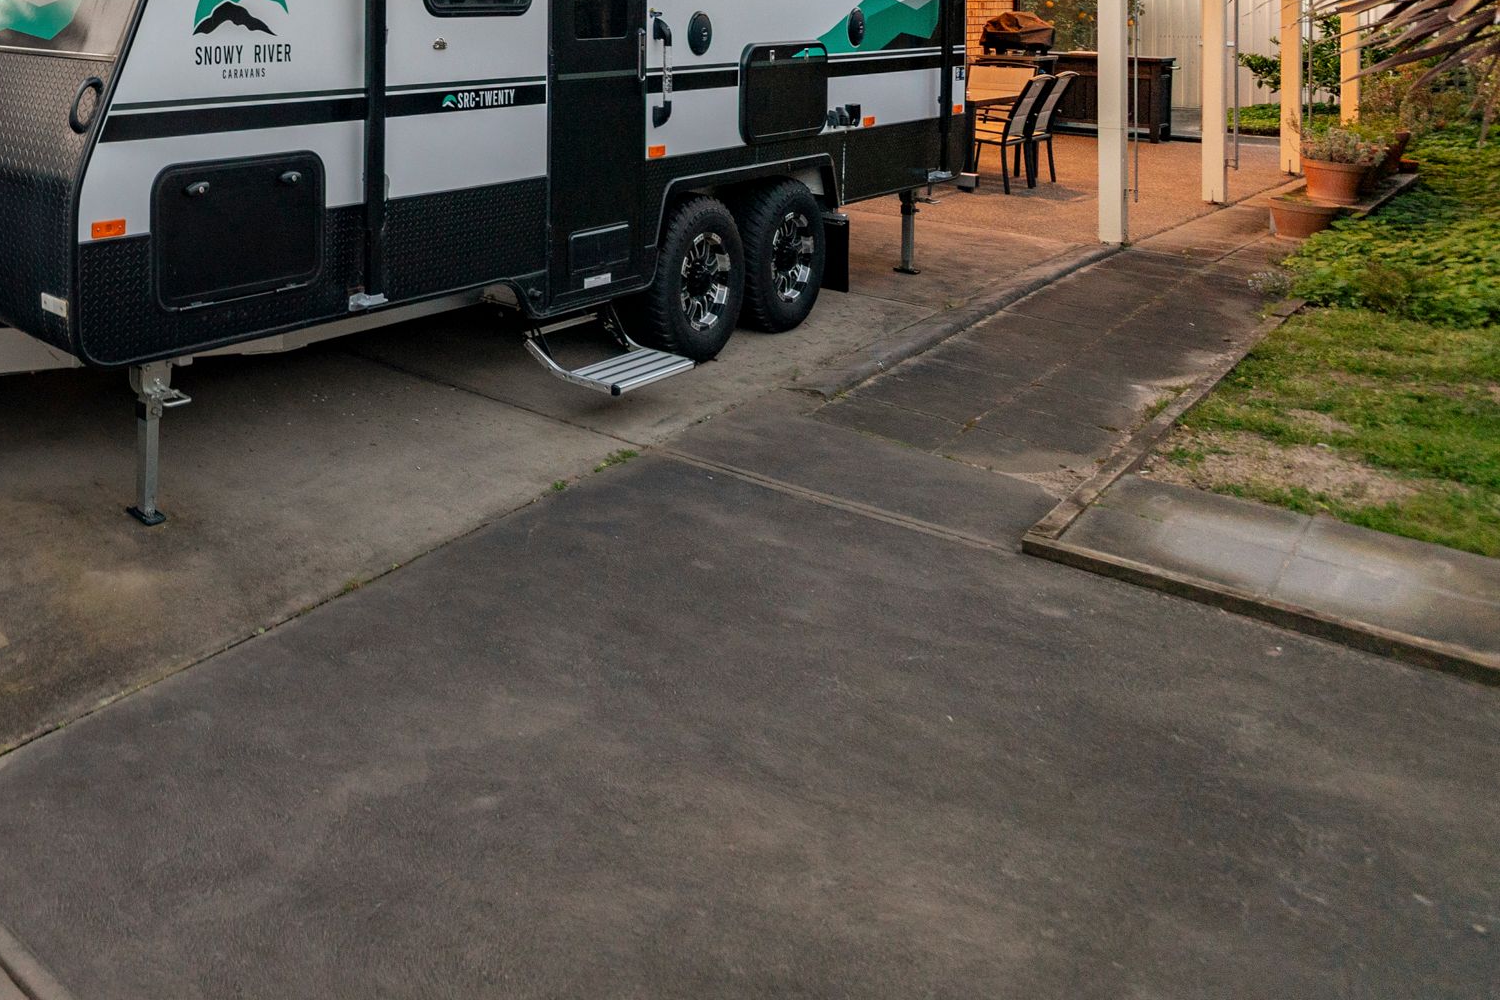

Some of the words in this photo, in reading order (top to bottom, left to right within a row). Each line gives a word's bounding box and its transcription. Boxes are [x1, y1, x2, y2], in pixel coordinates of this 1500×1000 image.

[195, 45, 243, 65] SNOWY
[254, 44, 291, 63] RIVER
[222, 68, 266, 79] CARAVANS
[457, 89, 516, 108] SRC-TWENTY
